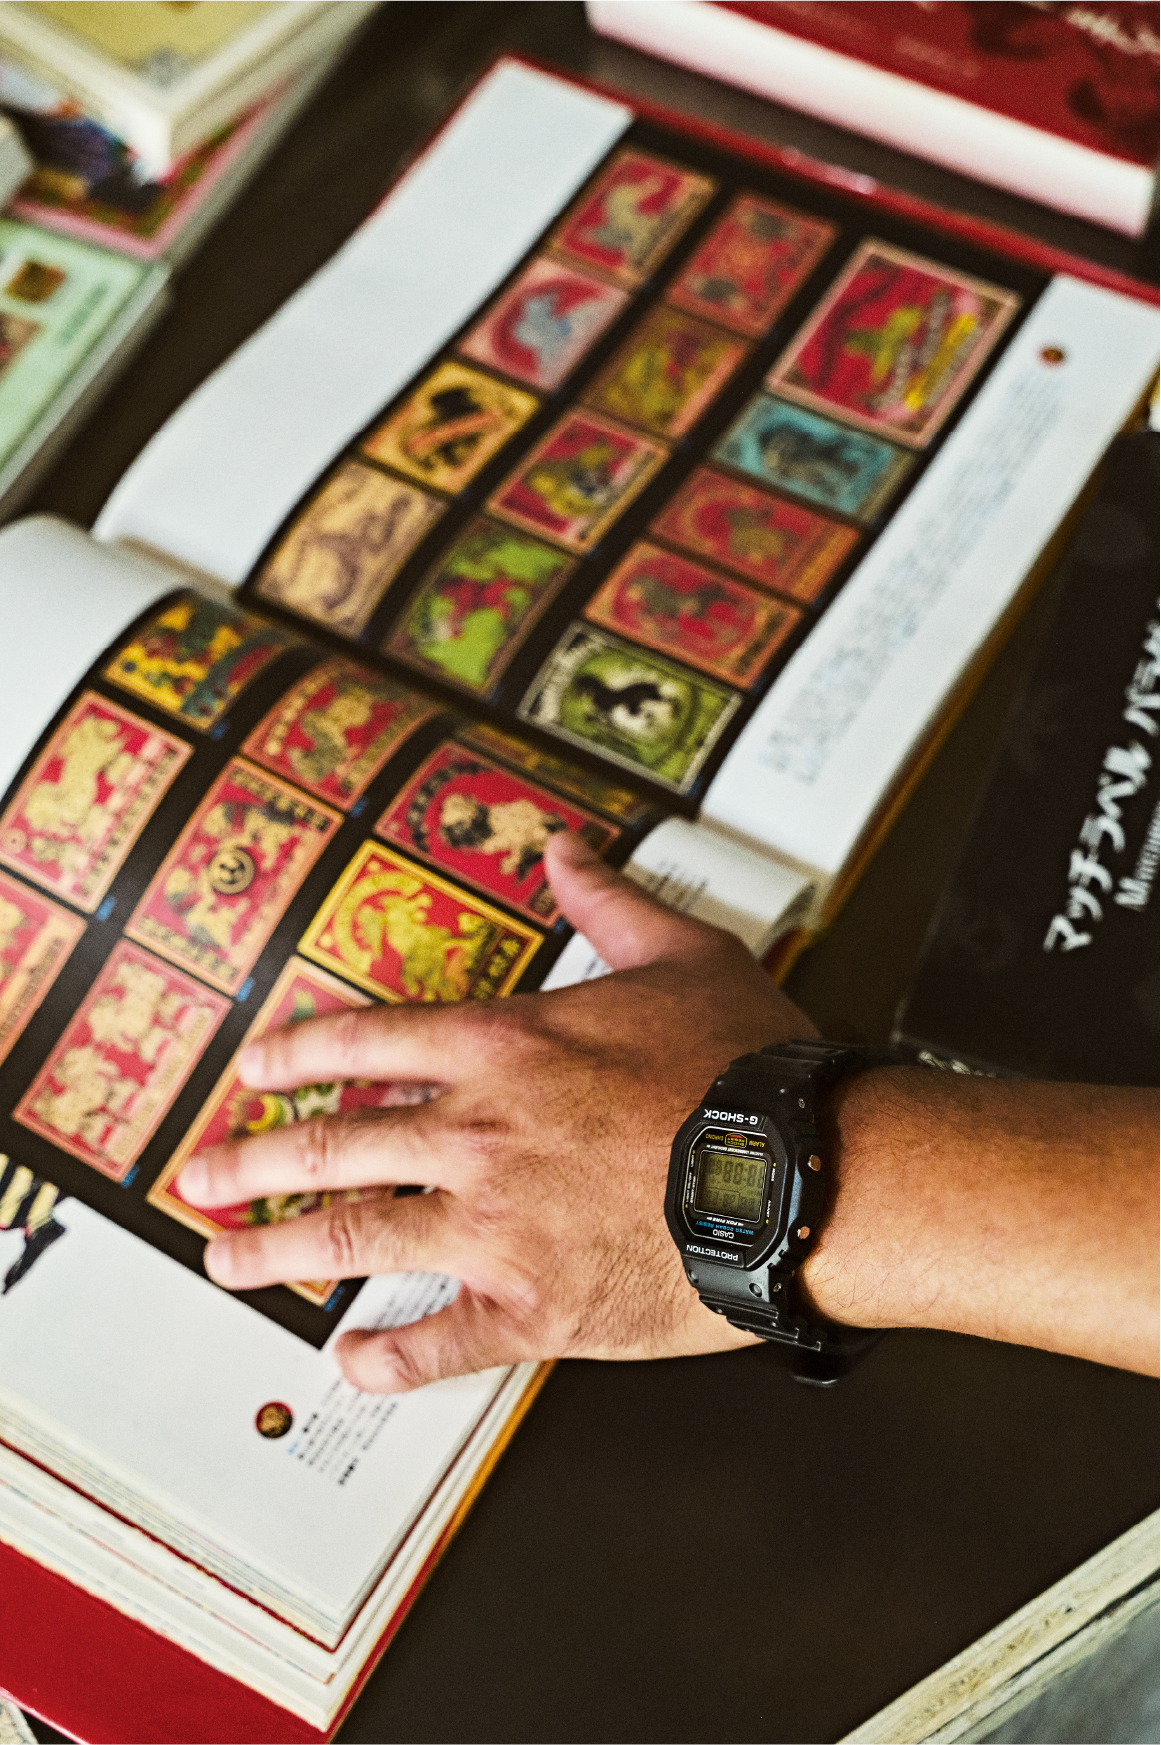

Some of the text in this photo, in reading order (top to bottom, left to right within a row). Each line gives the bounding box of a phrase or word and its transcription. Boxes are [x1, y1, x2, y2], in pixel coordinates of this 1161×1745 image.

[1042, 739, 1152, 952] マッチラベル
[703, 1109, 758, 1125] G-SHOCK
[705, 1133, 724, 1141] CHRONO
[748, 1140, 766, 1148] ALARM
[696, 1220, 715, 1228] RESIST
[712, 1229, 735, 1239] CASIO
[686, 1244, 739, 1261] PROTECTION
